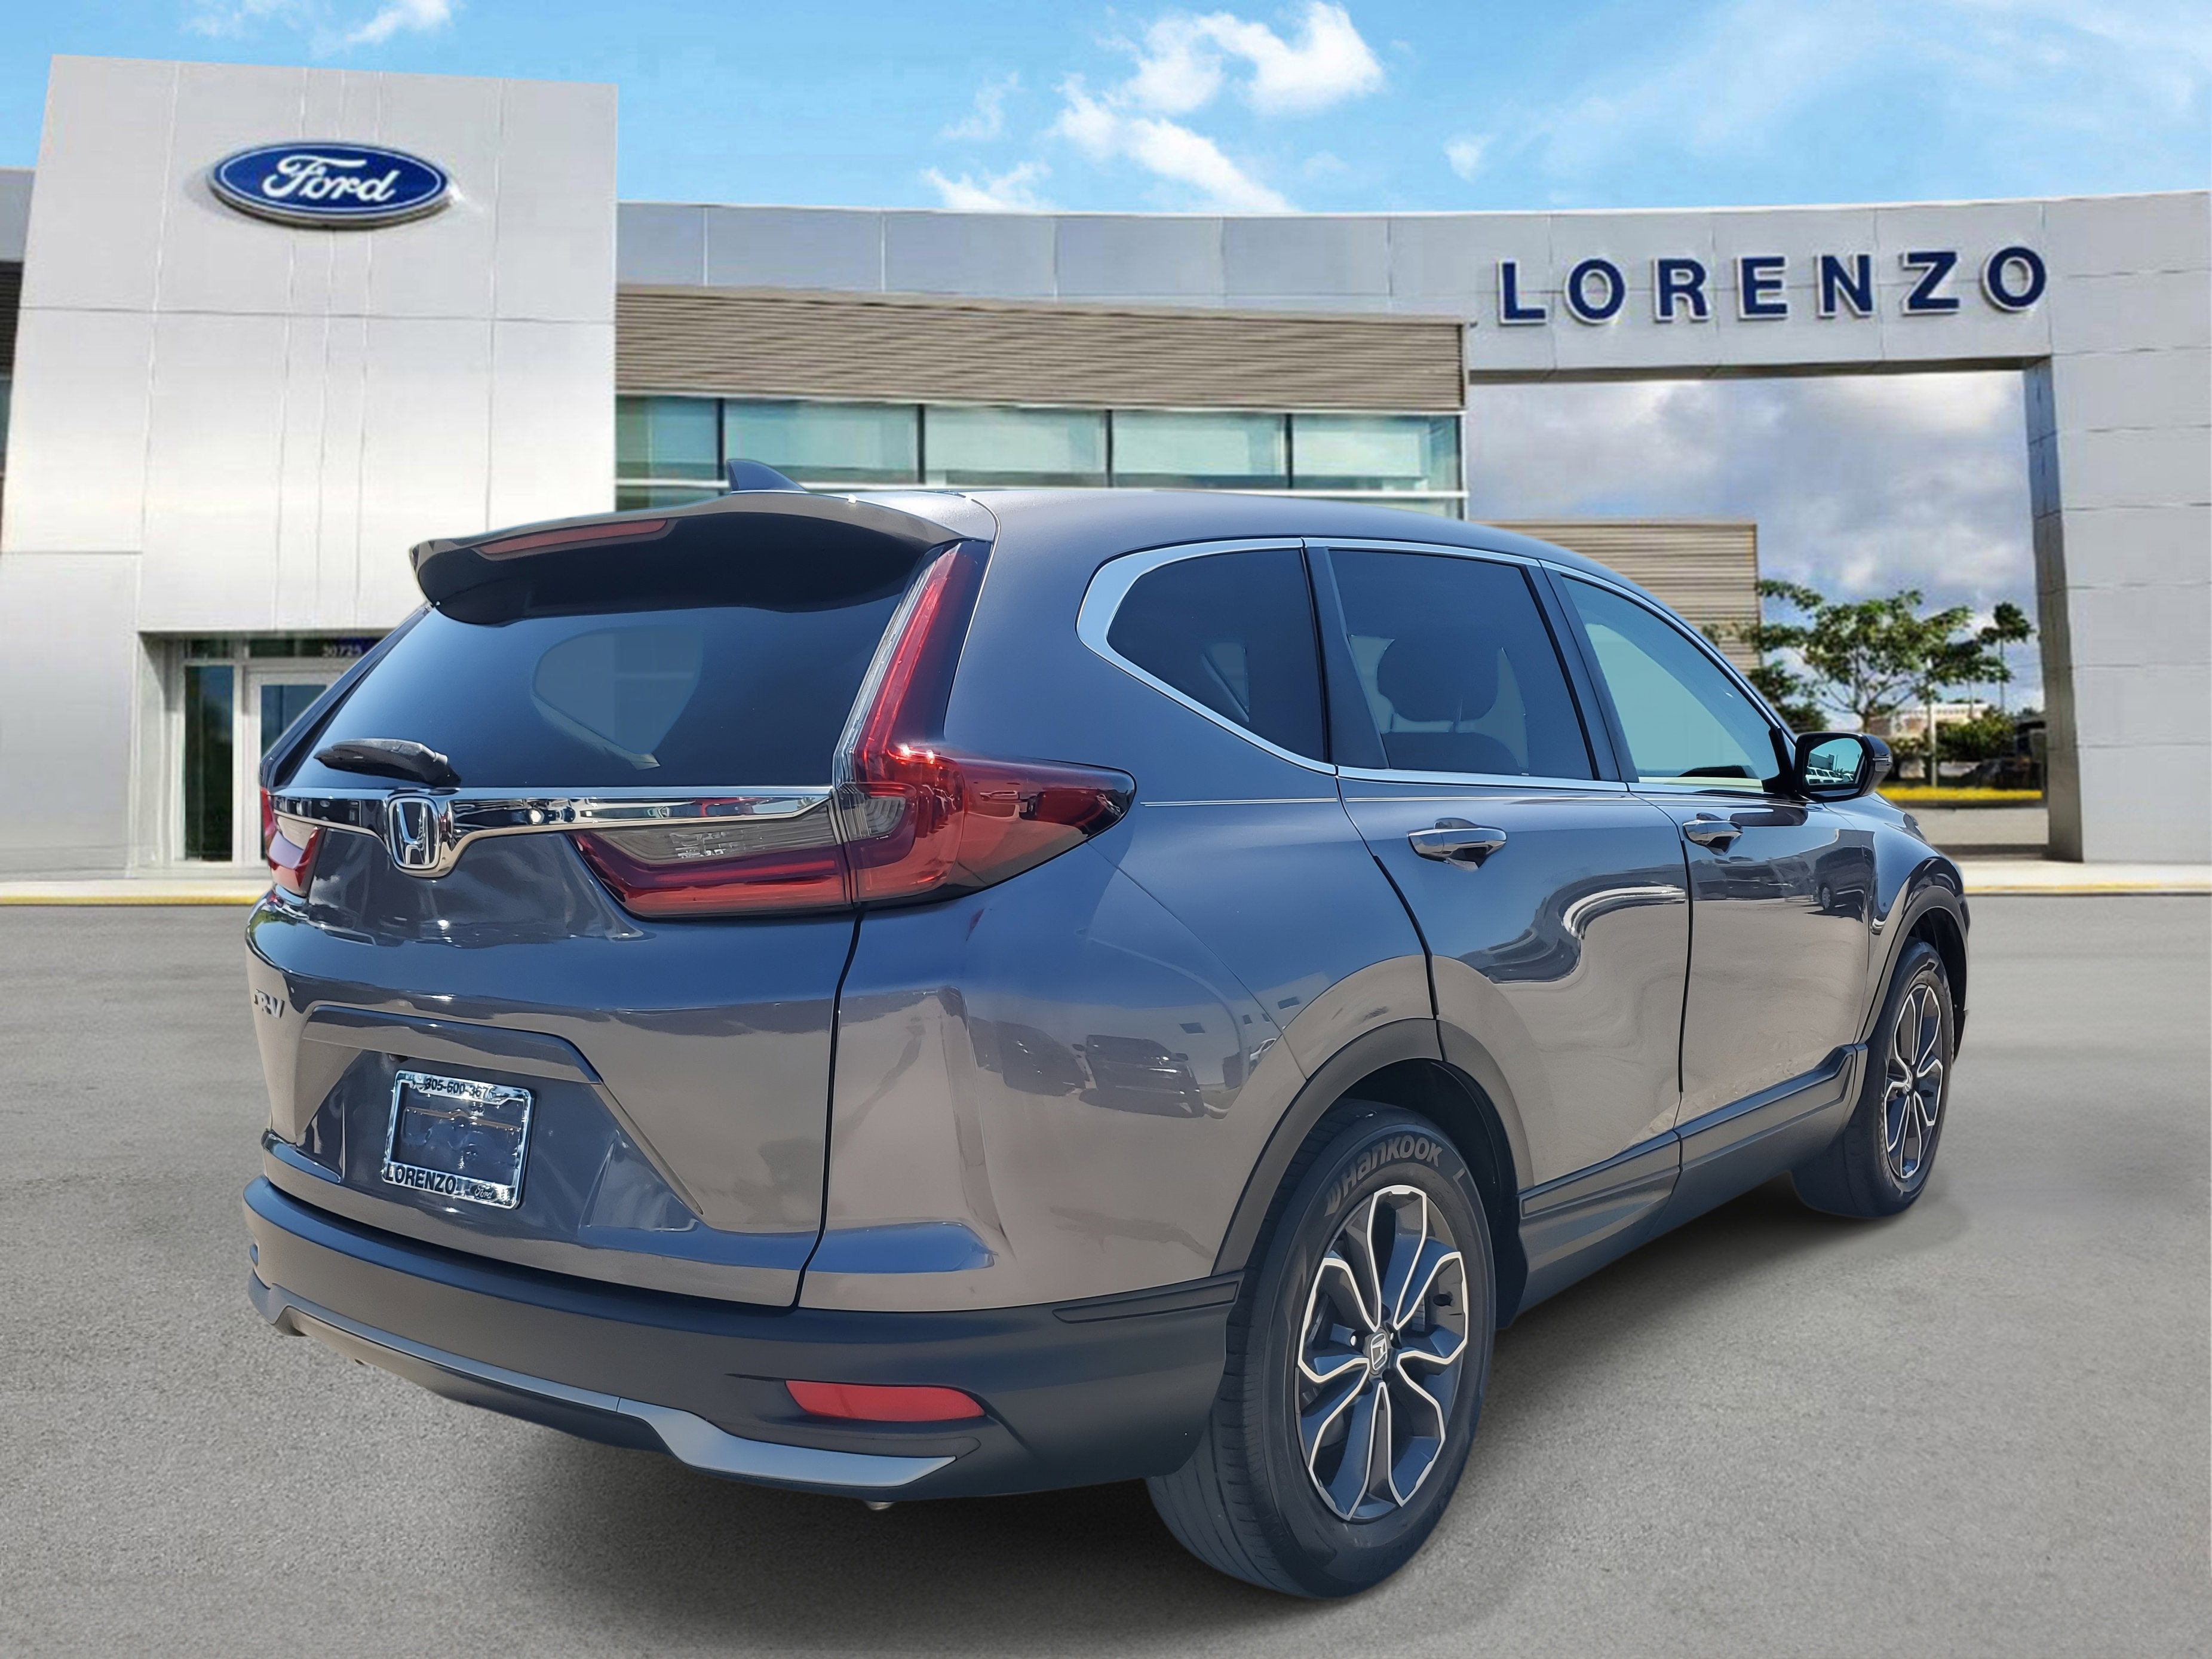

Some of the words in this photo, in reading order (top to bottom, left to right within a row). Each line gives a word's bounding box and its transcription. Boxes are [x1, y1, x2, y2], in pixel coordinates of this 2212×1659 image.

[262, 154, 400, 202] Ford
[1498, 246, 2048, 326] LORENZO
[385, 1162, 456, 1195] LORENZO
